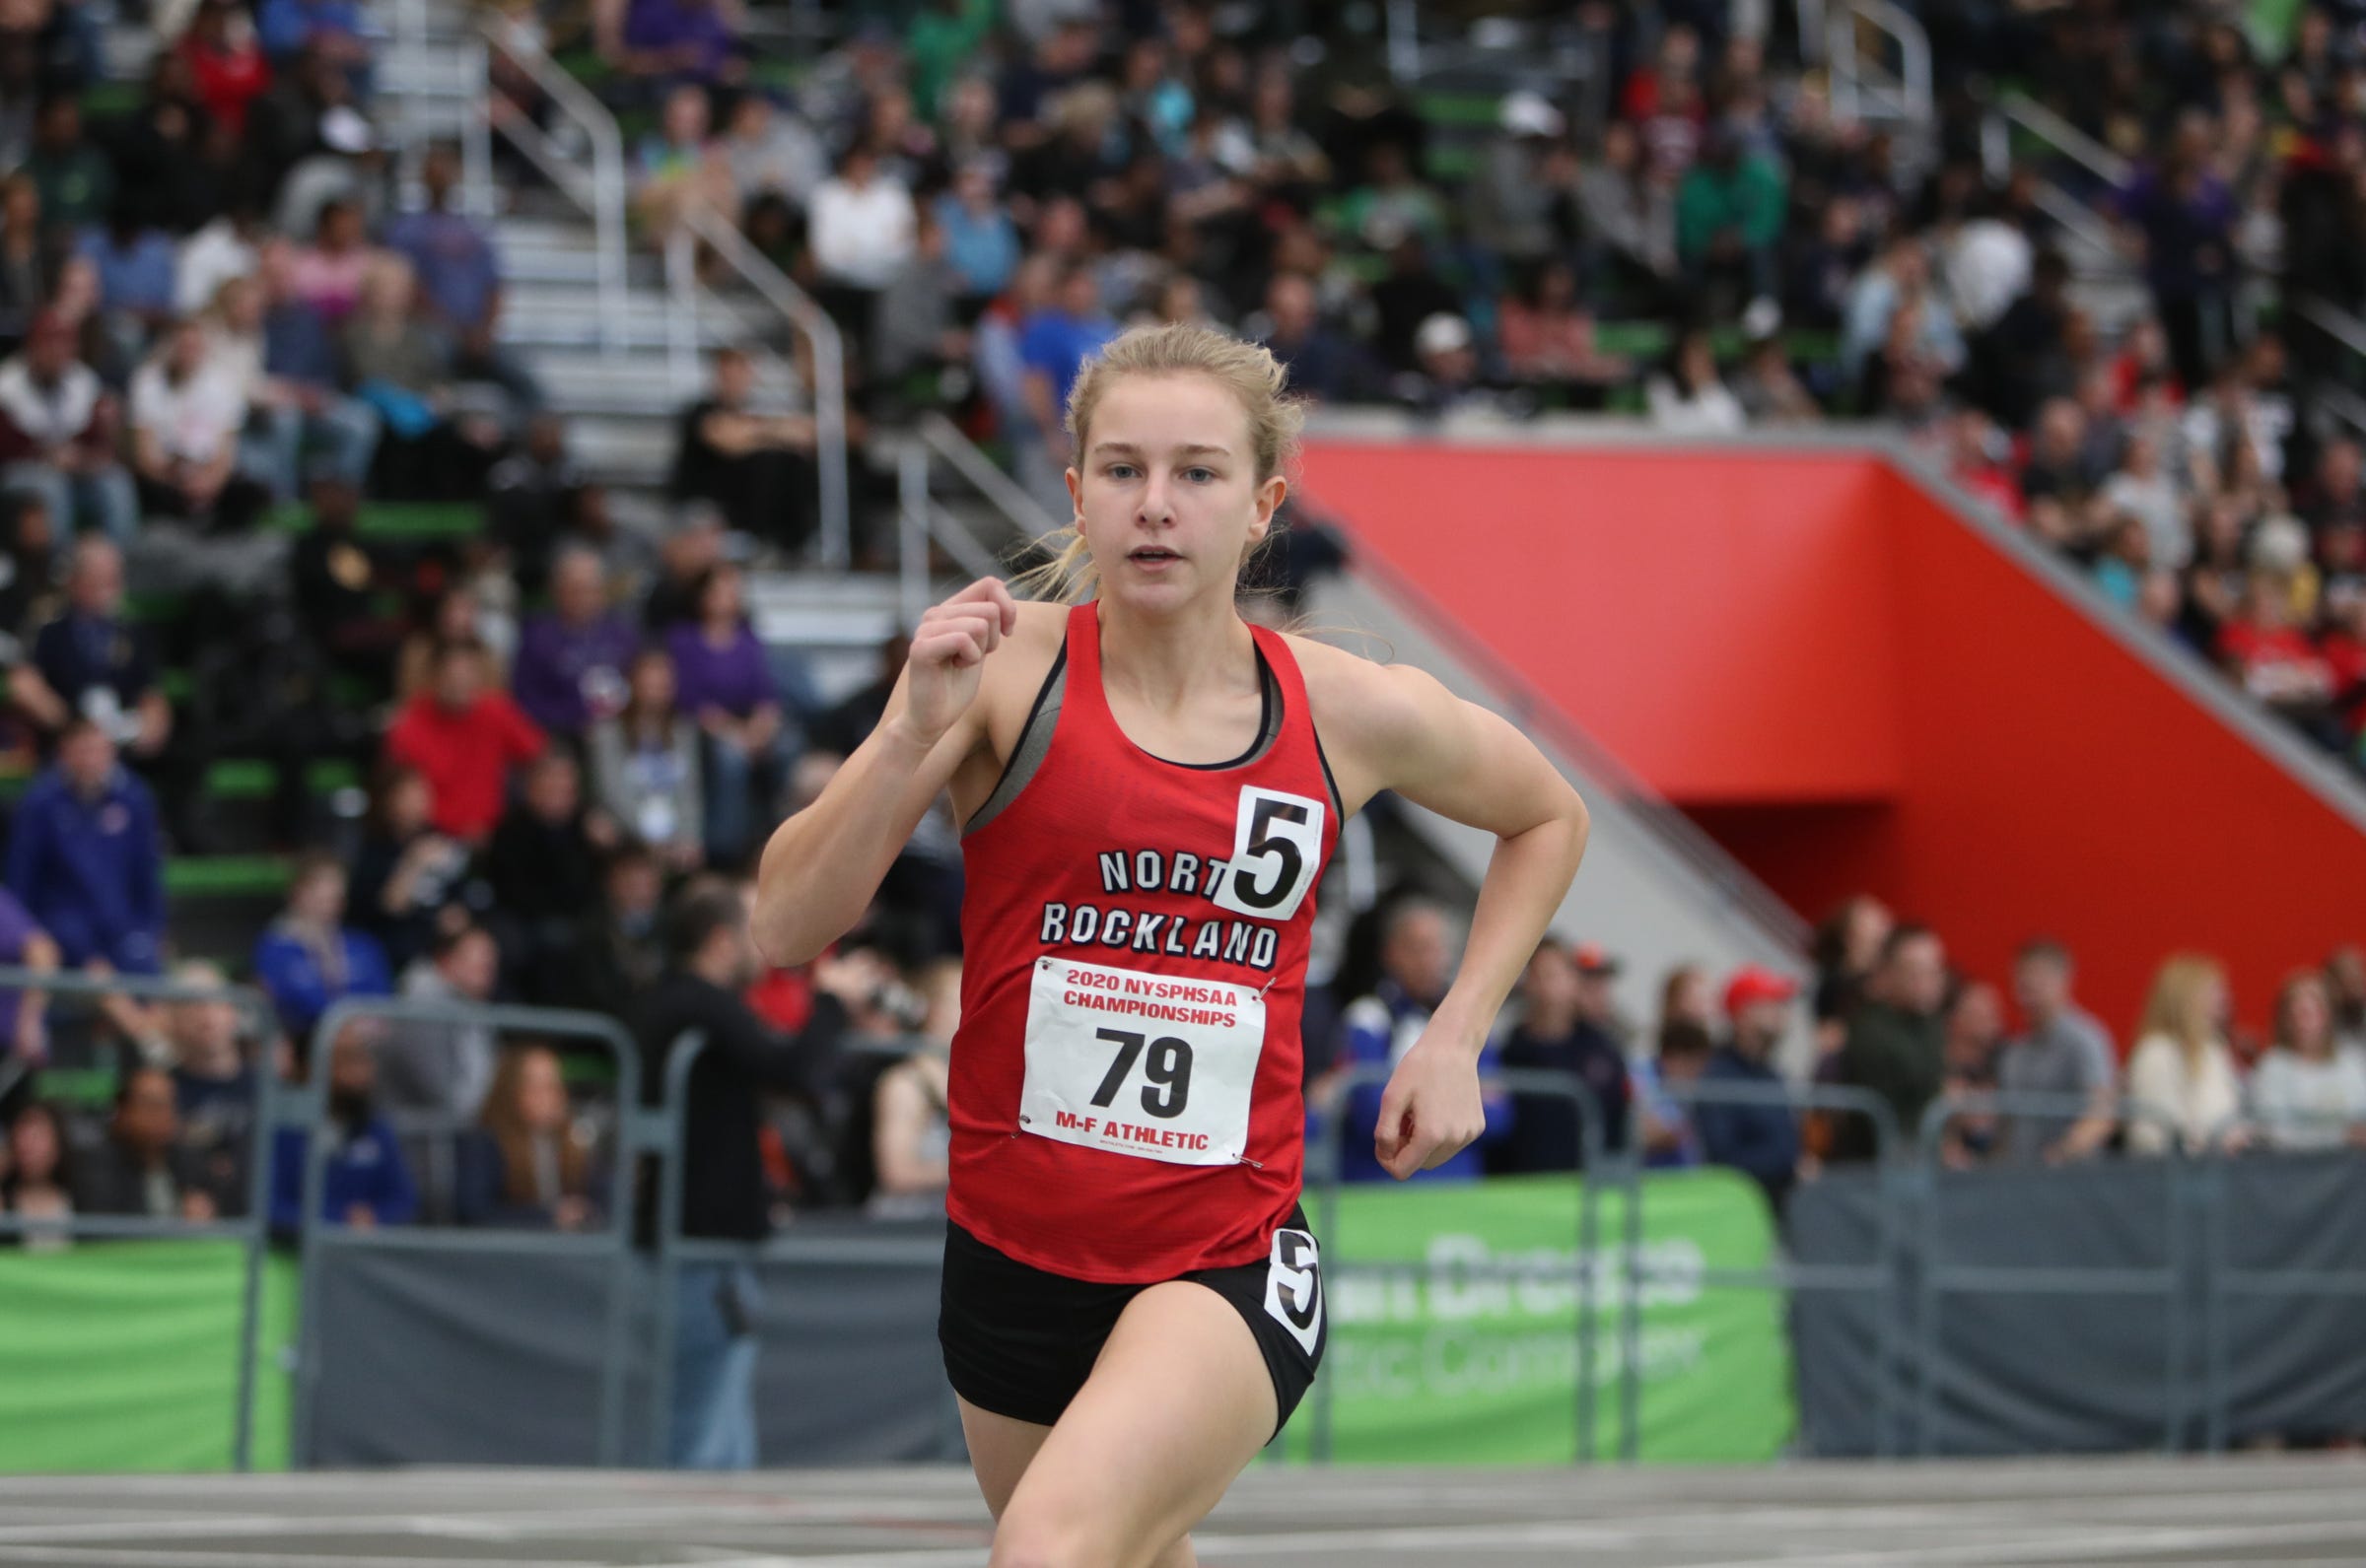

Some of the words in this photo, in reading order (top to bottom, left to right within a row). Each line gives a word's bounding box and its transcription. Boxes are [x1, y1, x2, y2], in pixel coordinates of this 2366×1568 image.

[1097, 849, 1232, 902] NORT
[1233, 797, 1308, 909] 5
[1039, 901, 1280, 972] ROCKLAND
[1063, 990, 1237, 1028] CHAMPIONSHIPS
[1066, 969, 1120, 990] 2020
[1124, 978, 1238, 1007] NYSPHSAA
[1089, 1027, 1194, 1120] 79
[1055, 1110, 1098, 1133] M-F
[1103, 1121, 1210, 1151] ATHLETIC
[1277, 1230, 1319, 1330] 5
